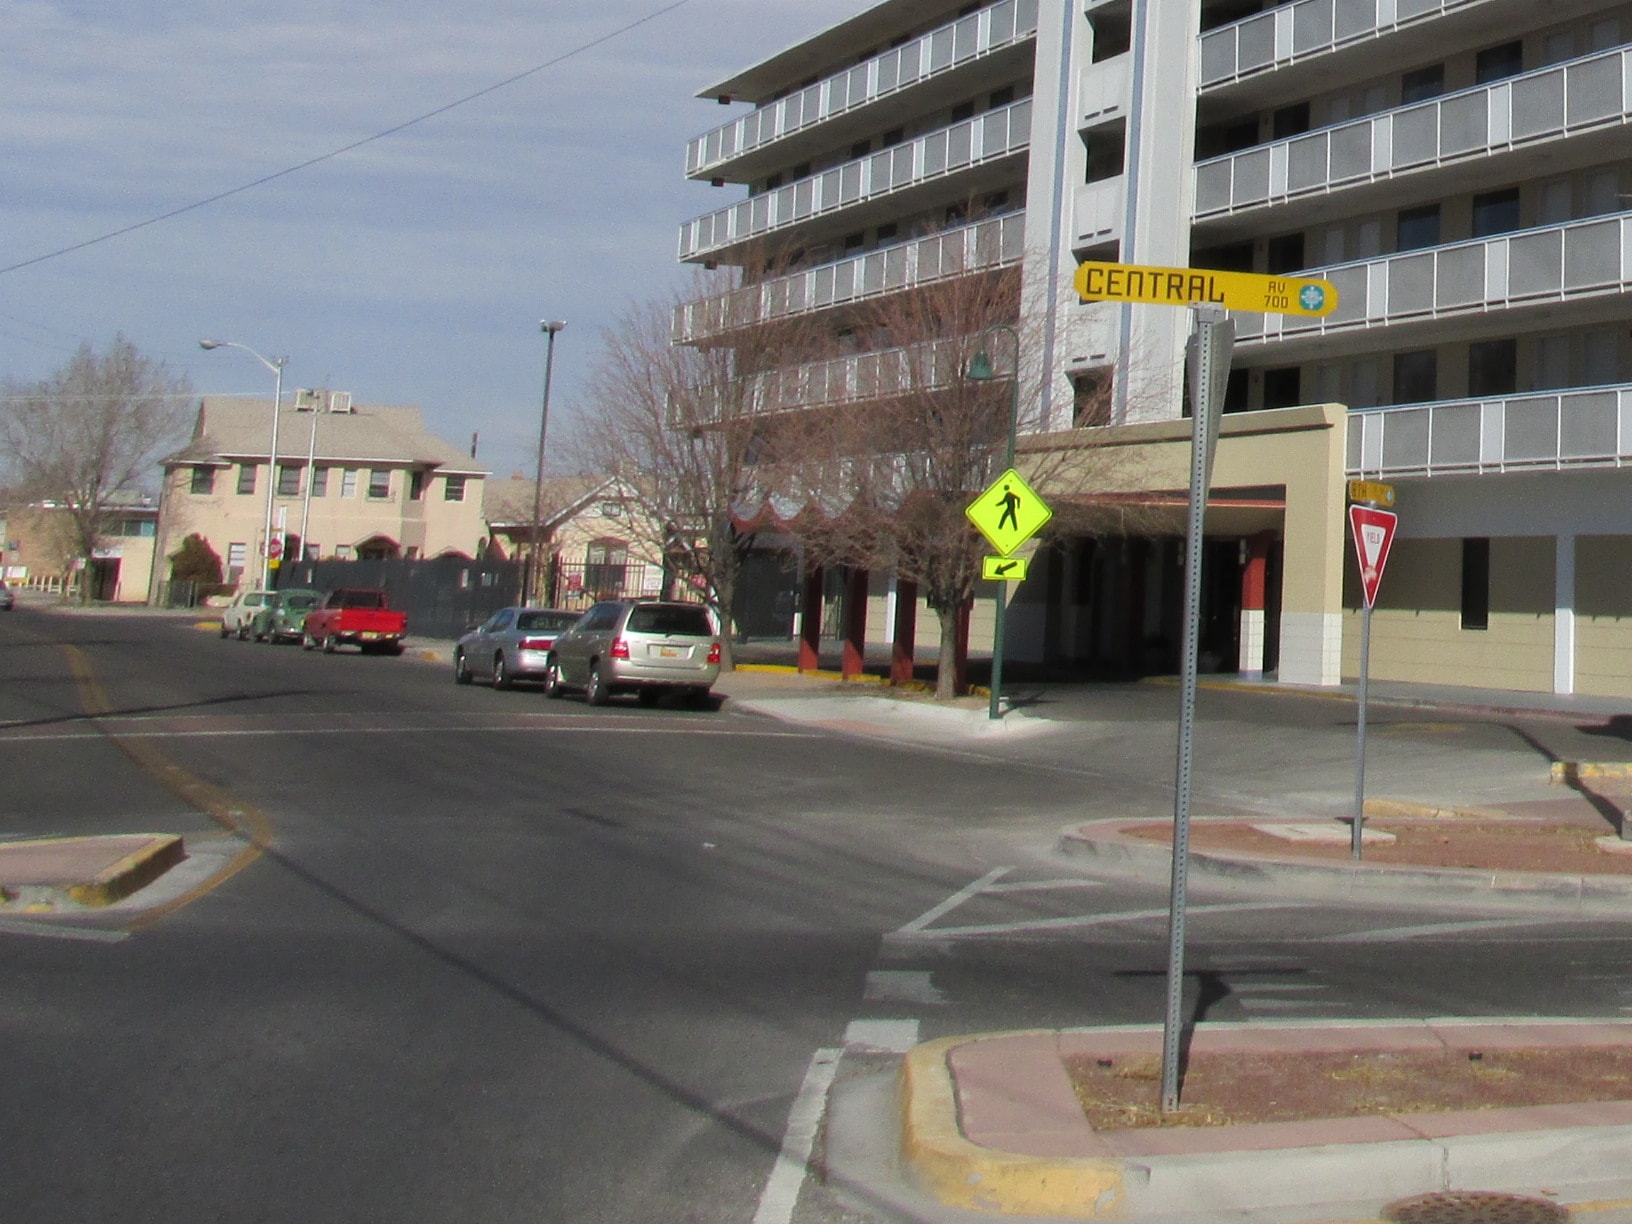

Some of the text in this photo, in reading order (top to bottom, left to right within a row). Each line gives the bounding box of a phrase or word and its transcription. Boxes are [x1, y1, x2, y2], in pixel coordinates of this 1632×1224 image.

[1086, 268, 1287, 303] CENTRAL AV
[1264, 295, 1289, 309] 700
